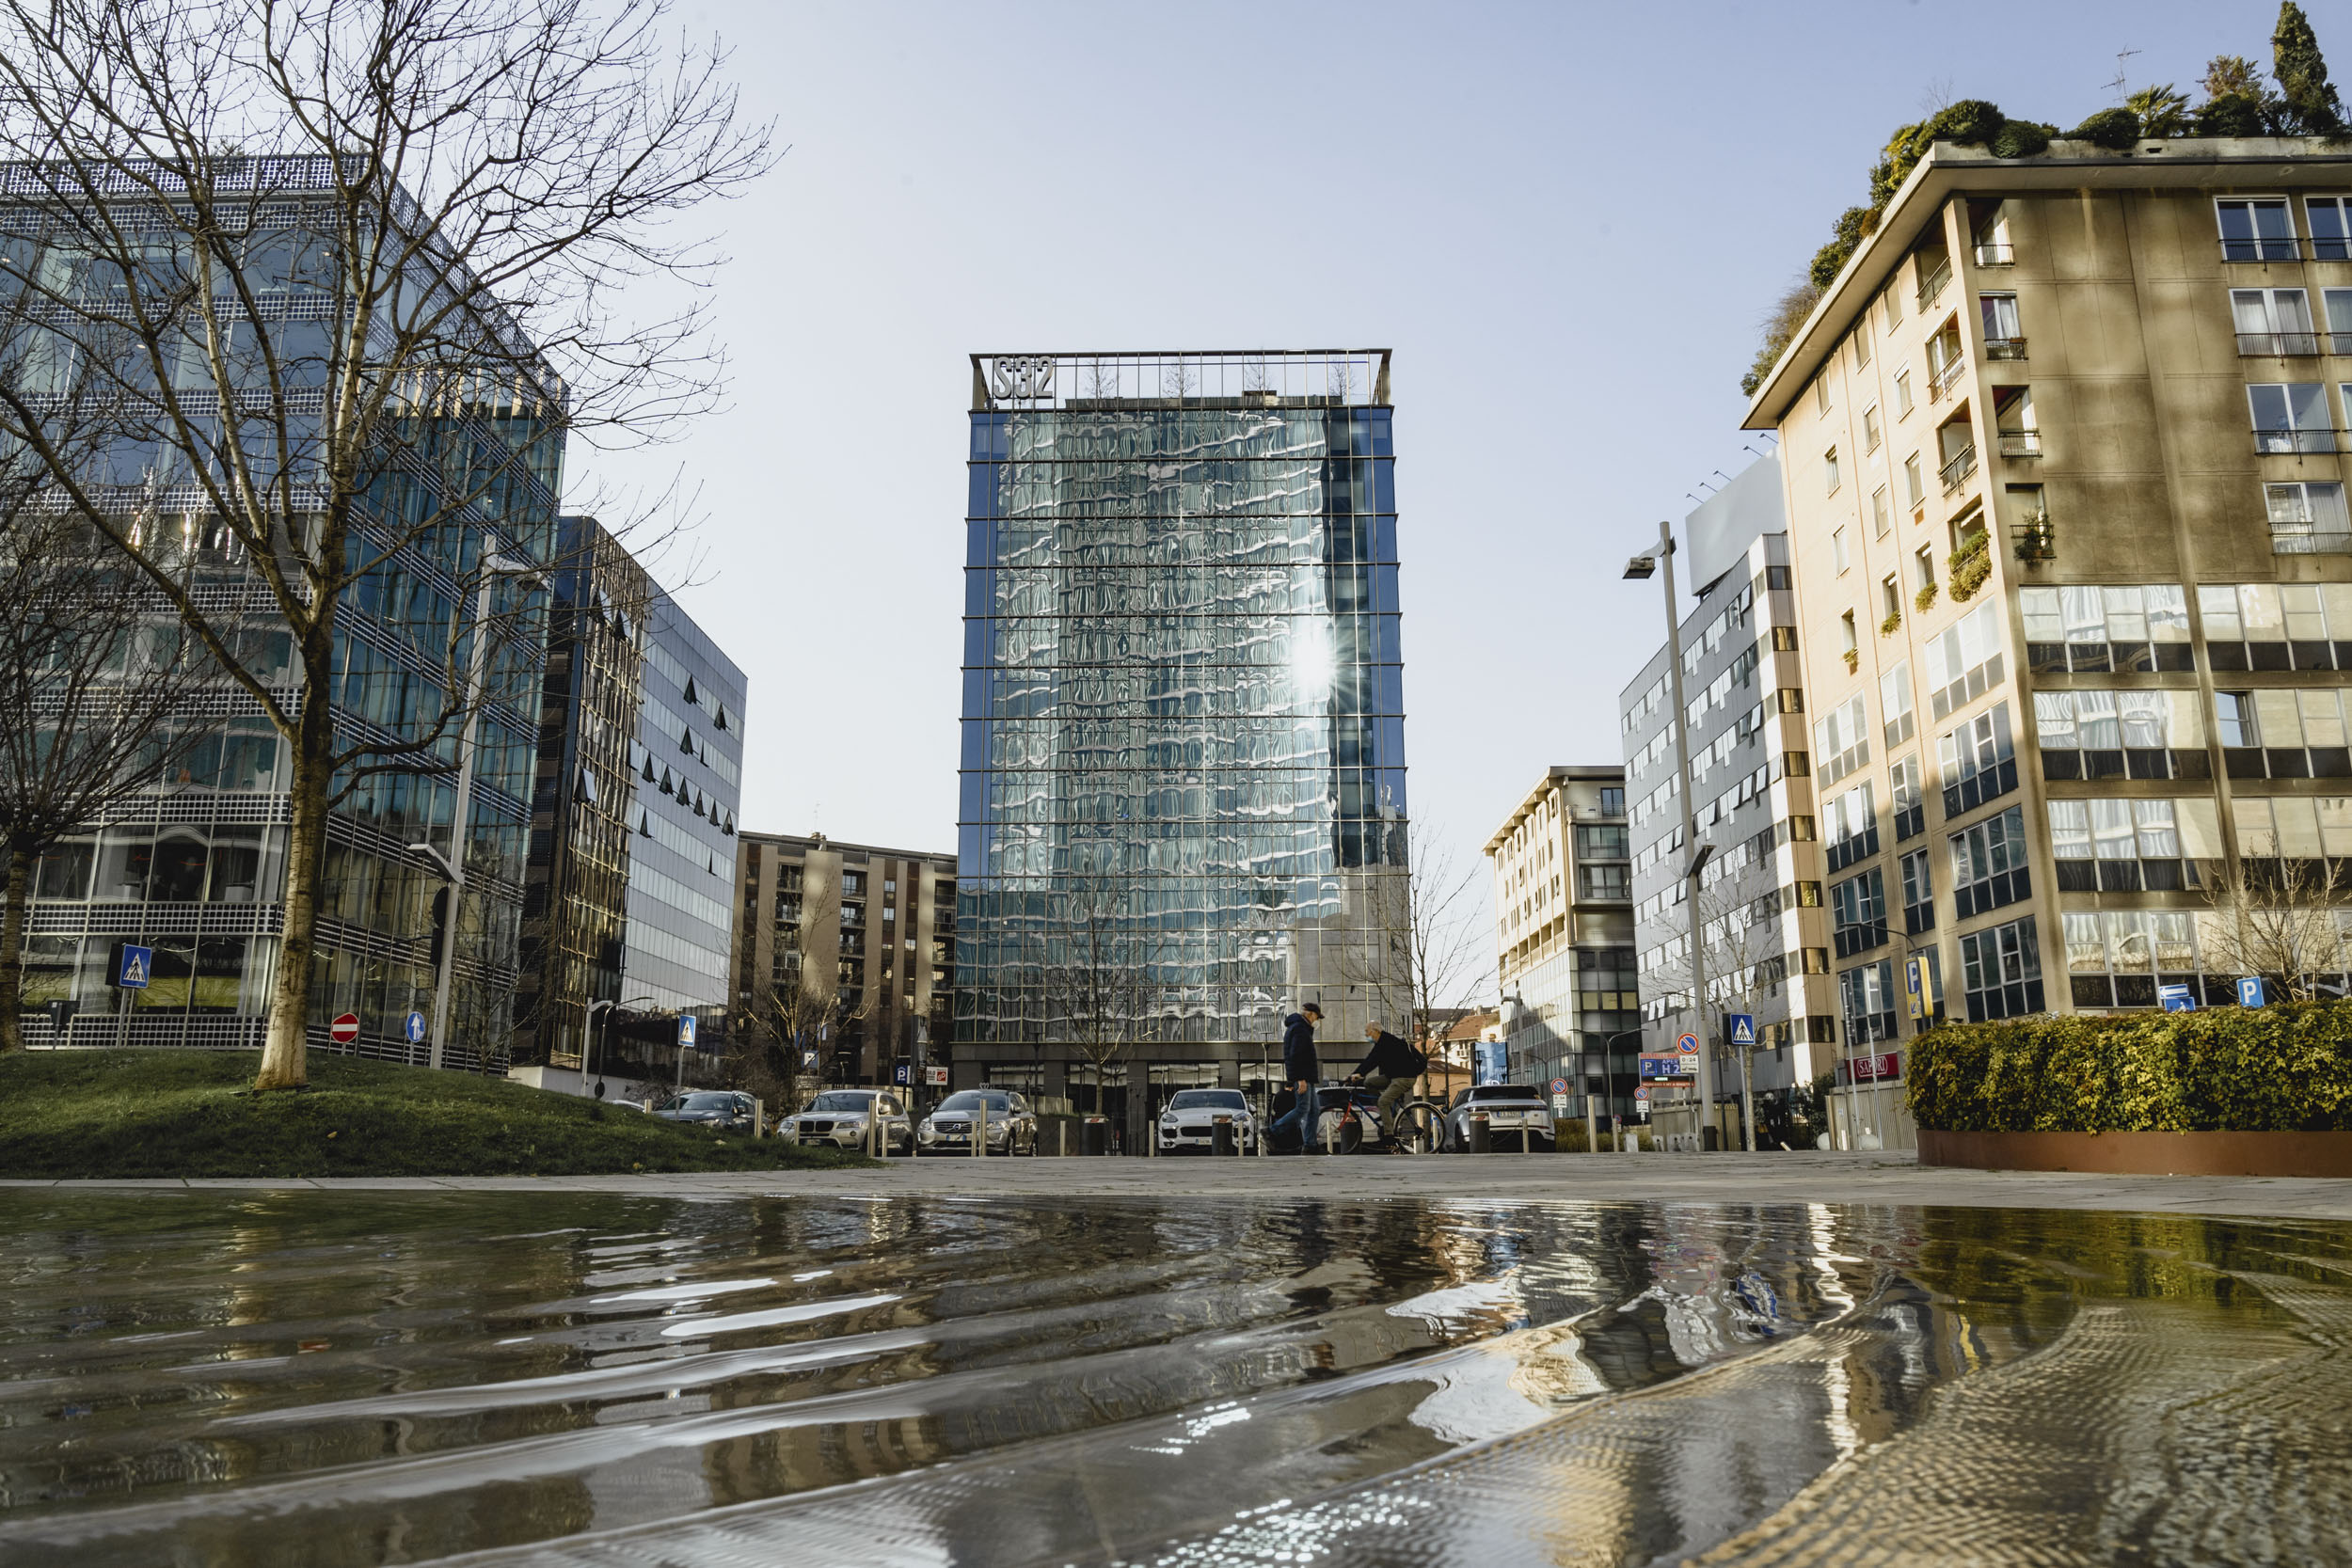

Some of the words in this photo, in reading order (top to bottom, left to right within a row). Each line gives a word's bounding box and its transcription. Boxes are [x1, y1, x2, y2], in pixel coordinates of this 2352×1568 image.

[993, 356, 1054, 399] S32
[2242, 981, 2257, 1004] P
[1645, 1061, 1653, 1072] P
[1661, 1065, 1671, 1074] H
[1673, 1065, 1680, 1074] 2
